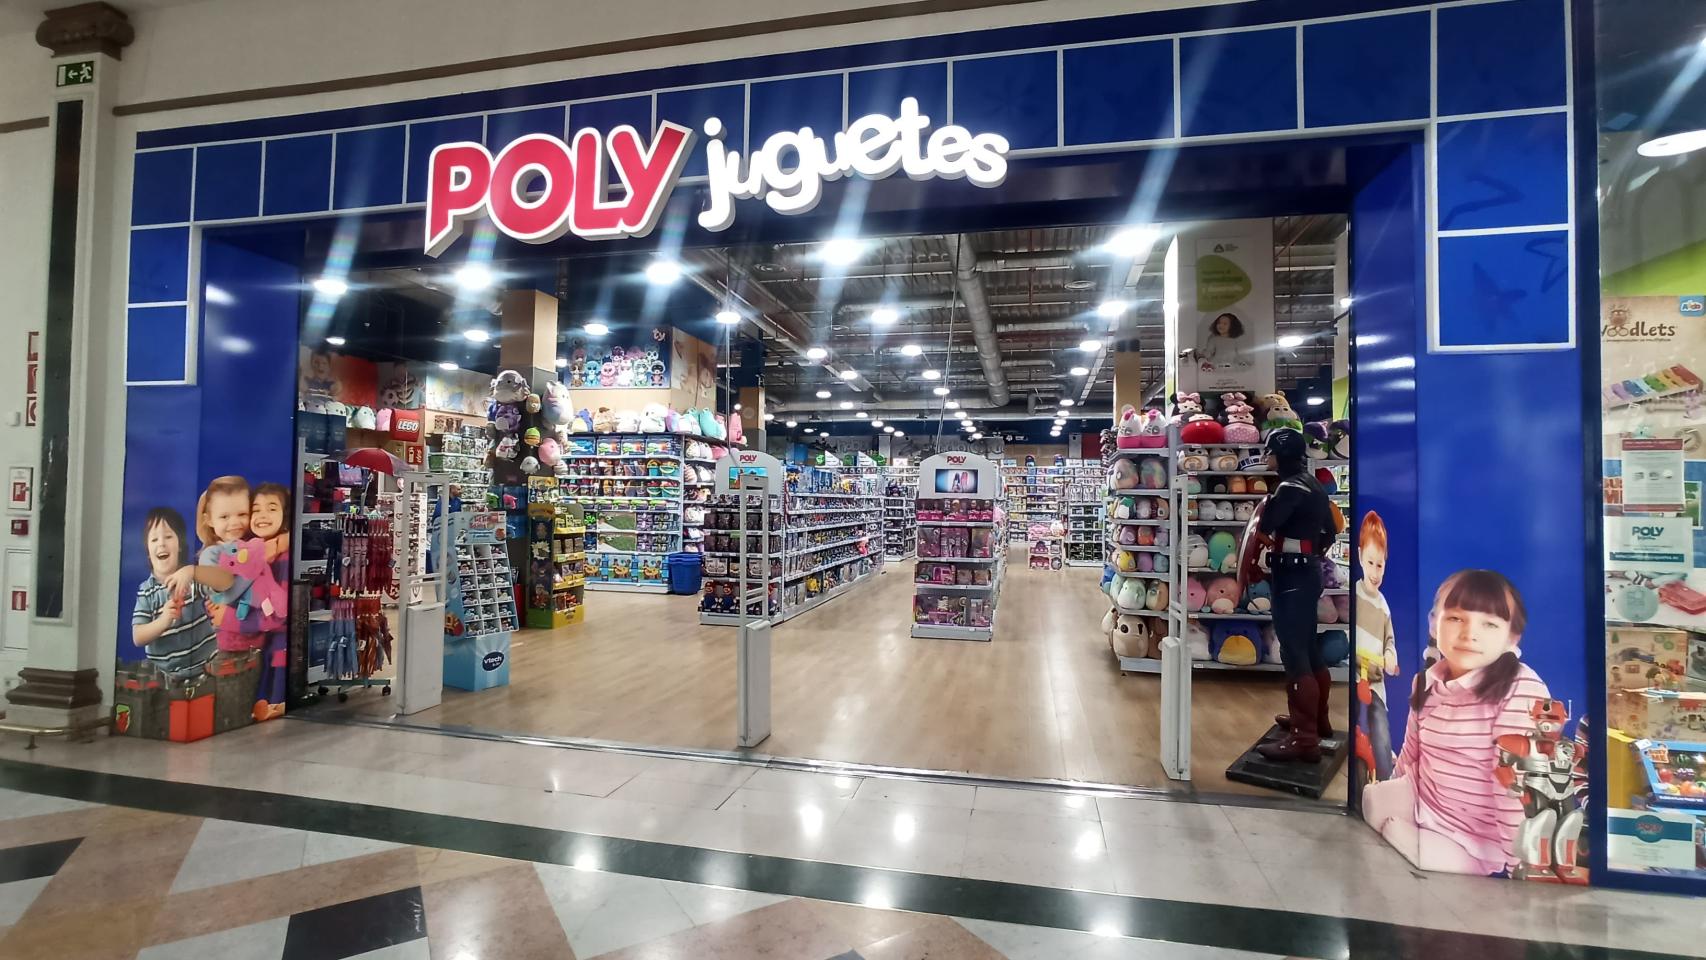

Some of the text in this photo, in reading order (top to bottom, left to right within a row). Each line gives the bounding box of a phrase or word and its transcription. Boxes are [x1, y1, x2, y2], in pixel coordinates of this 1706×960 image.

[425, 97, 1010, 256] POLY juguetes
[1601, 321, 1676, 337] oodlets
[652, 328, 666, 342] ty
[398, 420, 419, 431] LEGO
[739, 454, 758, 462] POLY
[946, 455, 967, 464] POLY
[1631, 526, 1664, 537] POLY
